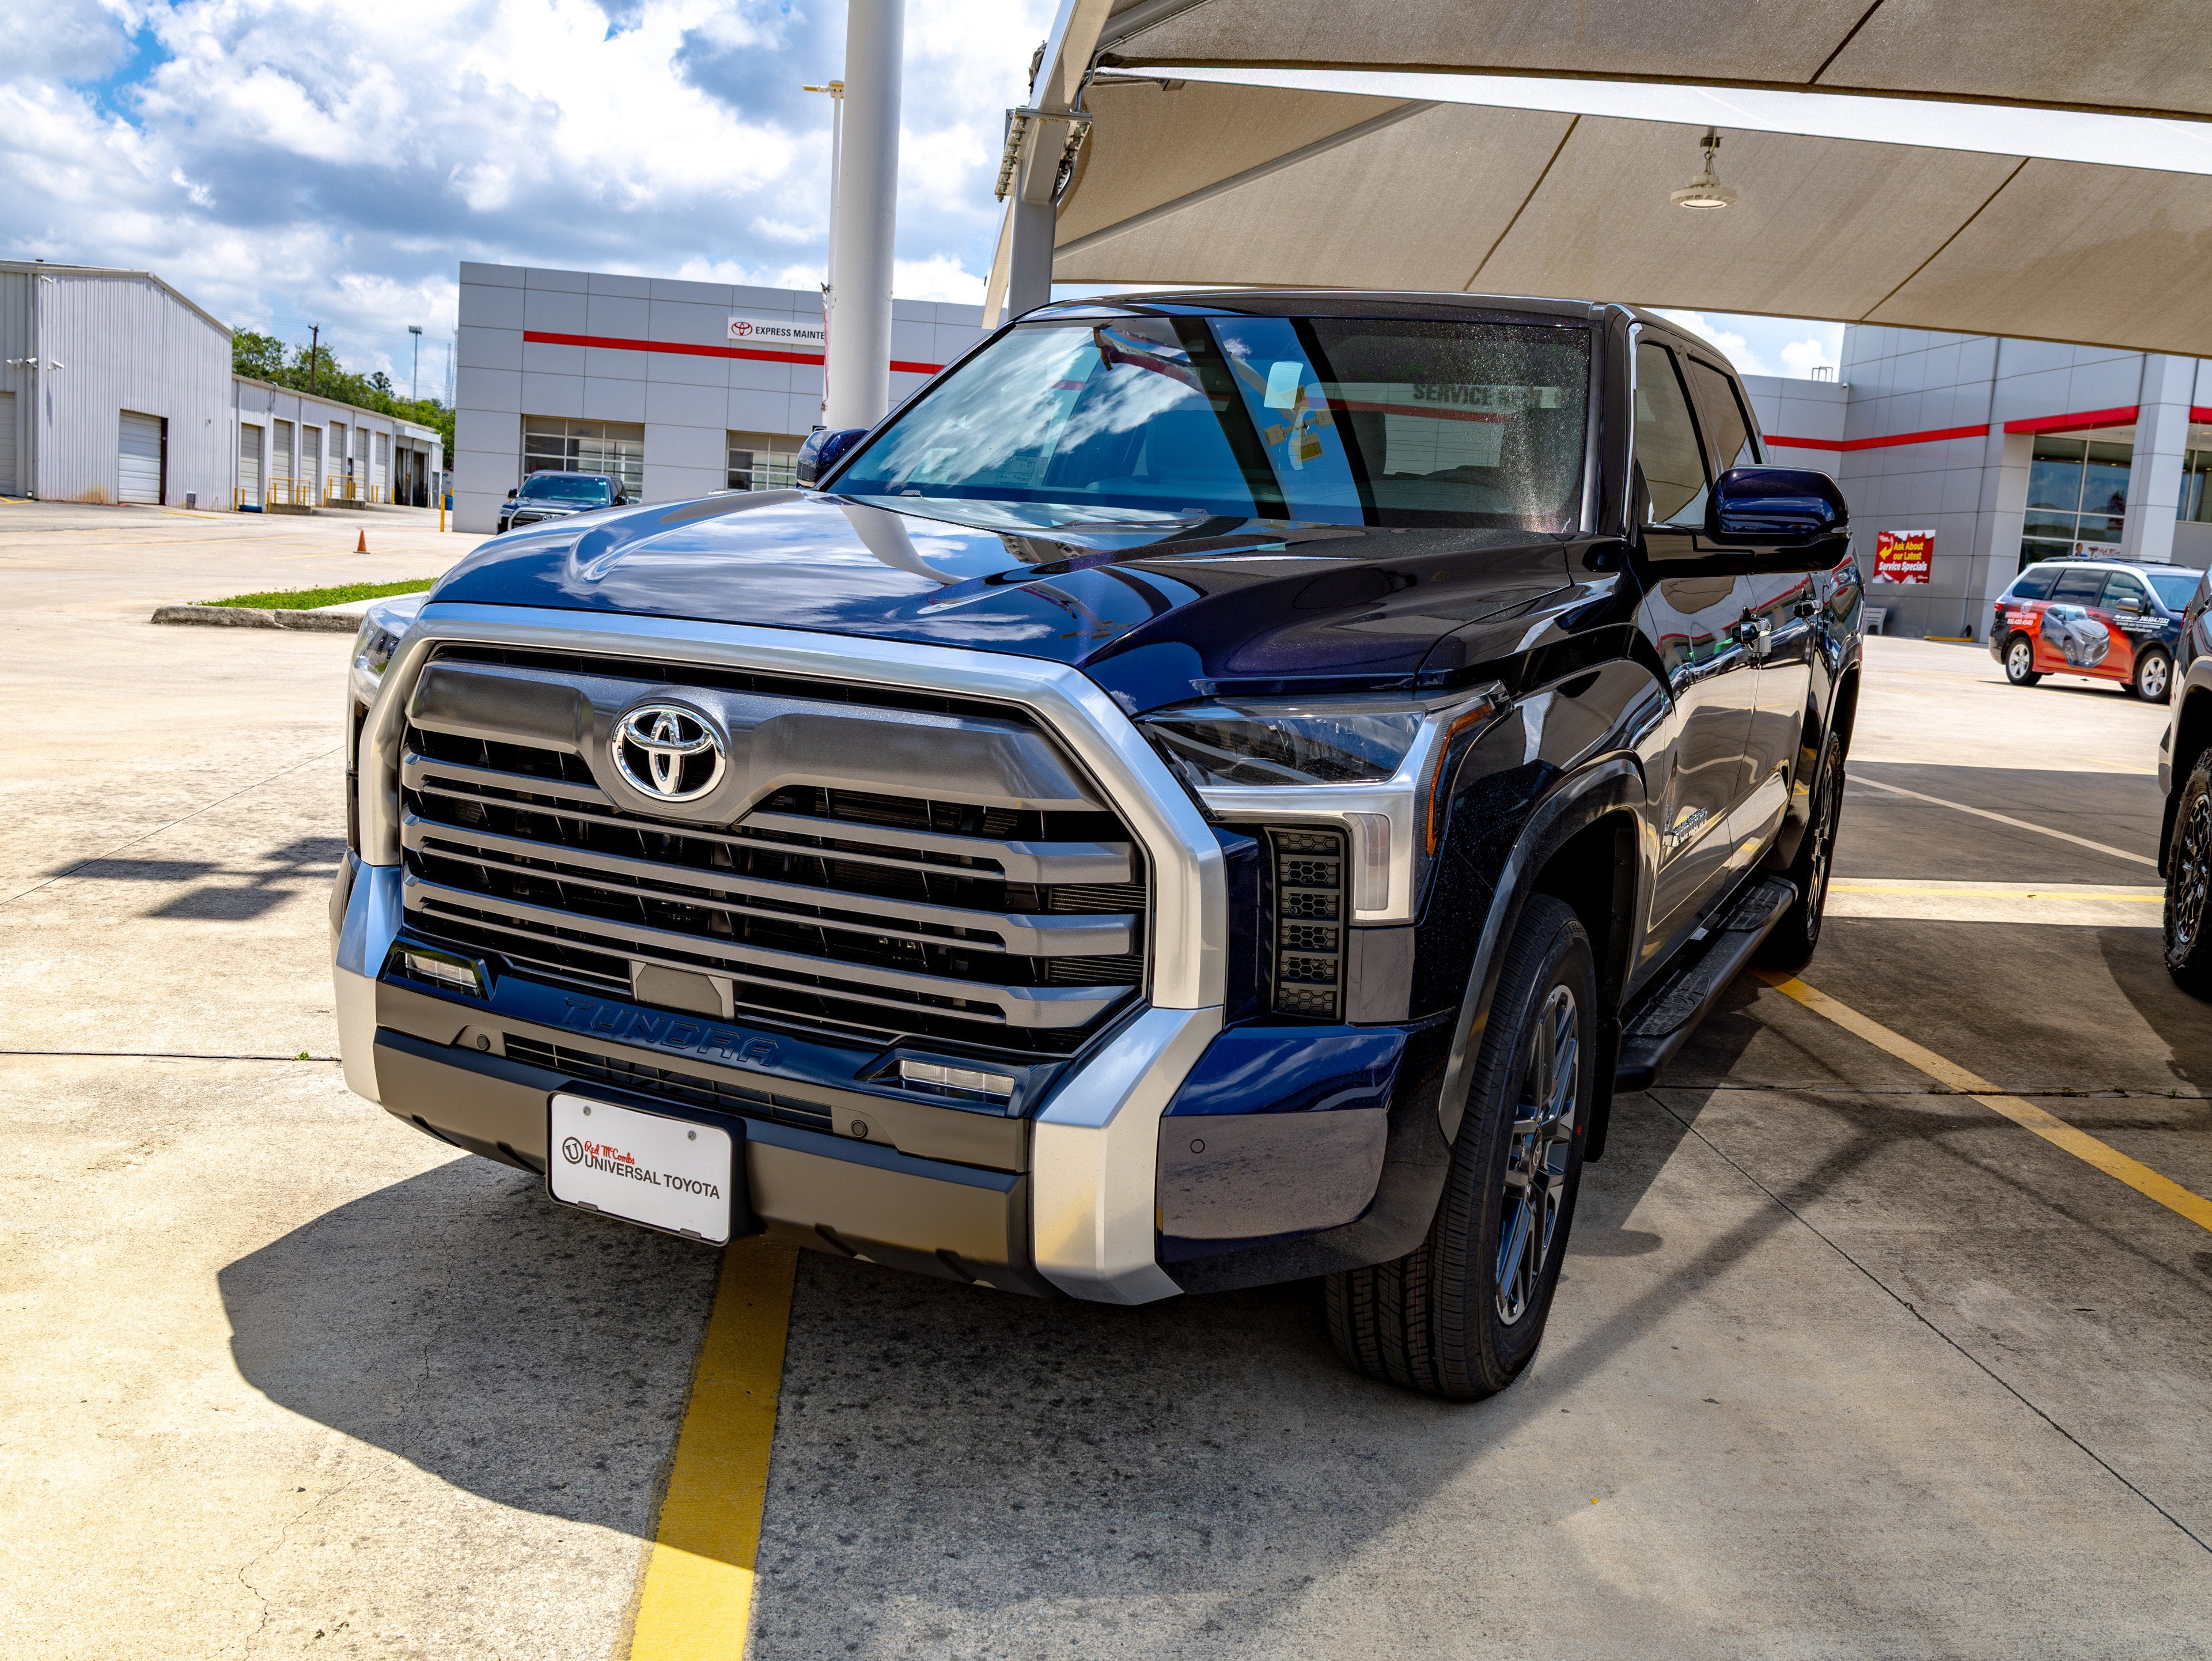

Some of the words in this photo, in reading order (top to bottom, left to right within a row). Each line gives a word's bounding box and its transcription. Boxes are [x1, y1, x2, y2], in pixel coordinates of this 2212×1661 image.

[755, 326, 791, 336] EXPRESS
[1413, 383, 1493, 406] SERVICE
[1893, 542, 1904, 550] Ask
[1905, 542, 1923, 551] About
[1903, 552, 1922, 561] Latest
[1878, 561, 1901, 571] Service
[1902, 561, 1928, 572] Specials
[562, 997, 779, 1067] TUNDRA
[585, 1140, 600, 1159] Red
[601, 1144, 635, 1165] McCombs
[585, 1154, 661, 1185] UNIVERSAL
[663, 1174, 720, 1200] TOYOTA
